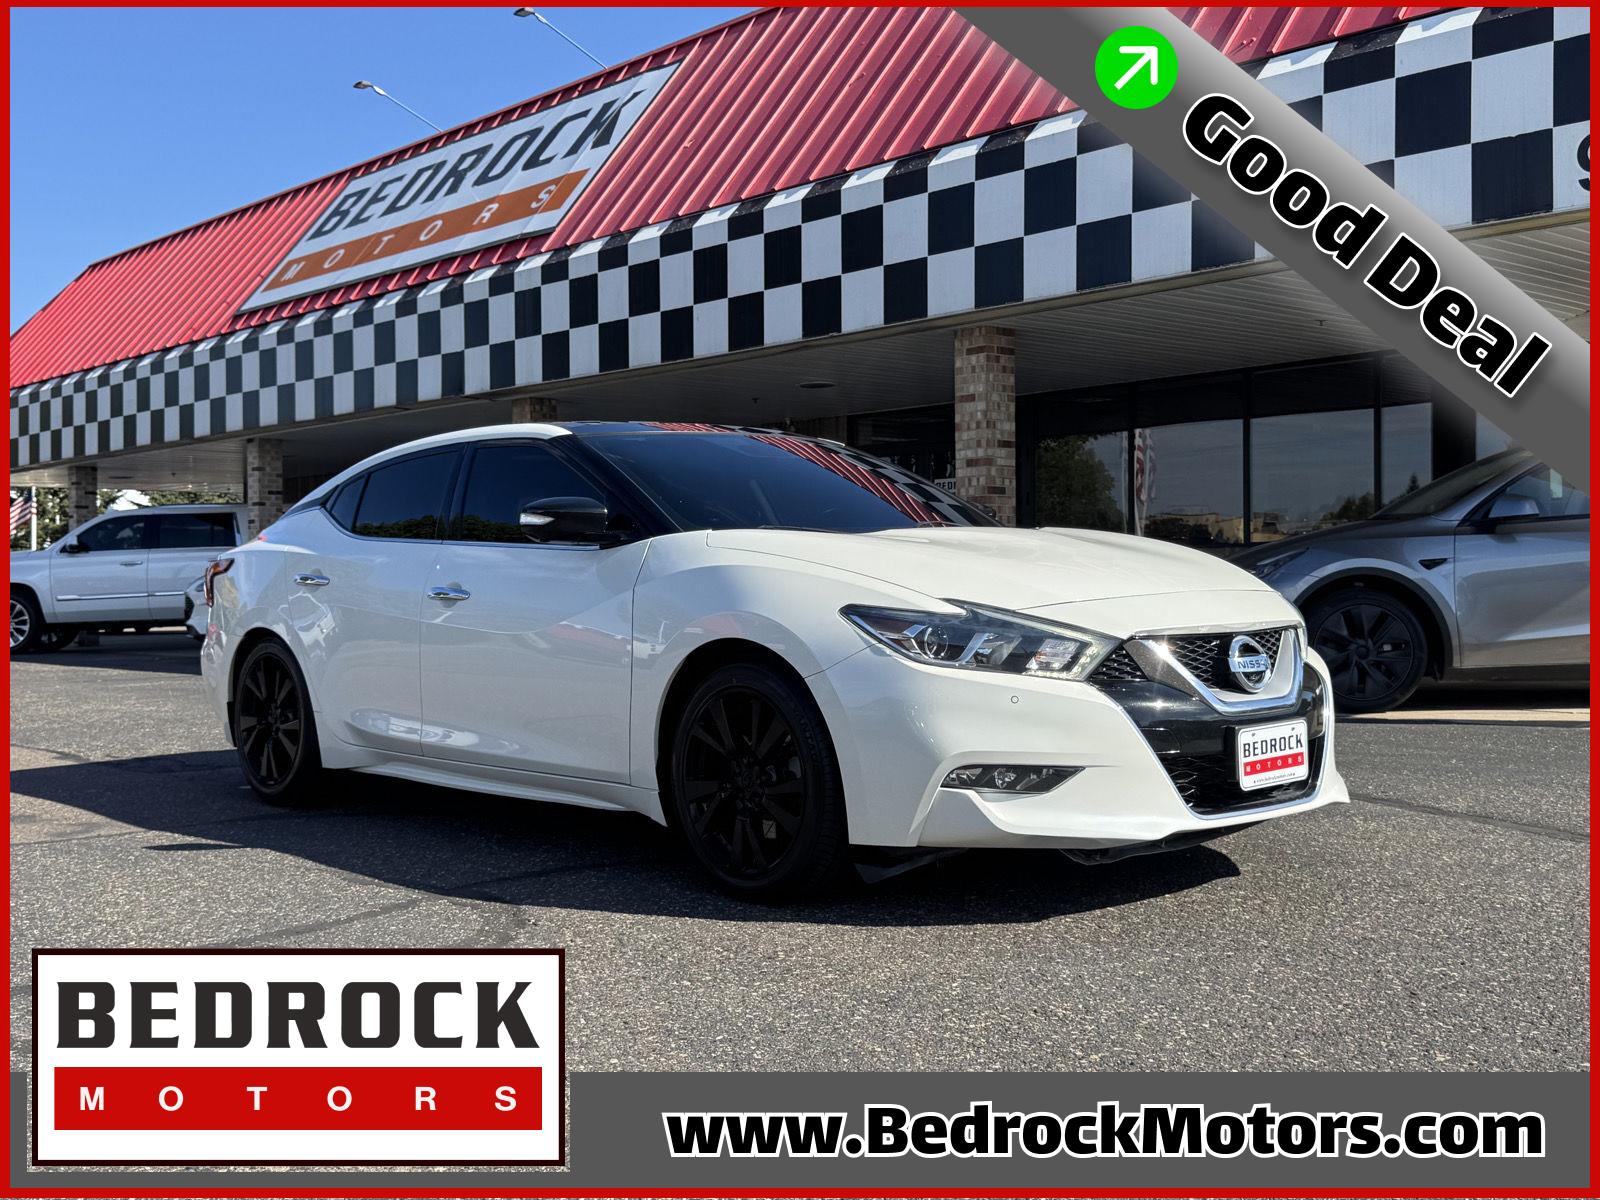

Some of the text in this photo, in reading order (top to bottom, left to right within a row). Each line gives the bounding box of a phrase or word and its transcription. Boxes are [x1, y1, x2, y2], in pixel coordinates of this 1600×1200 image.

[306, 89, 648, 242] BEDROCK
[280, 183, 557, 281] MOTORS
[1243, 733, 1303, 759] BEDROCK
